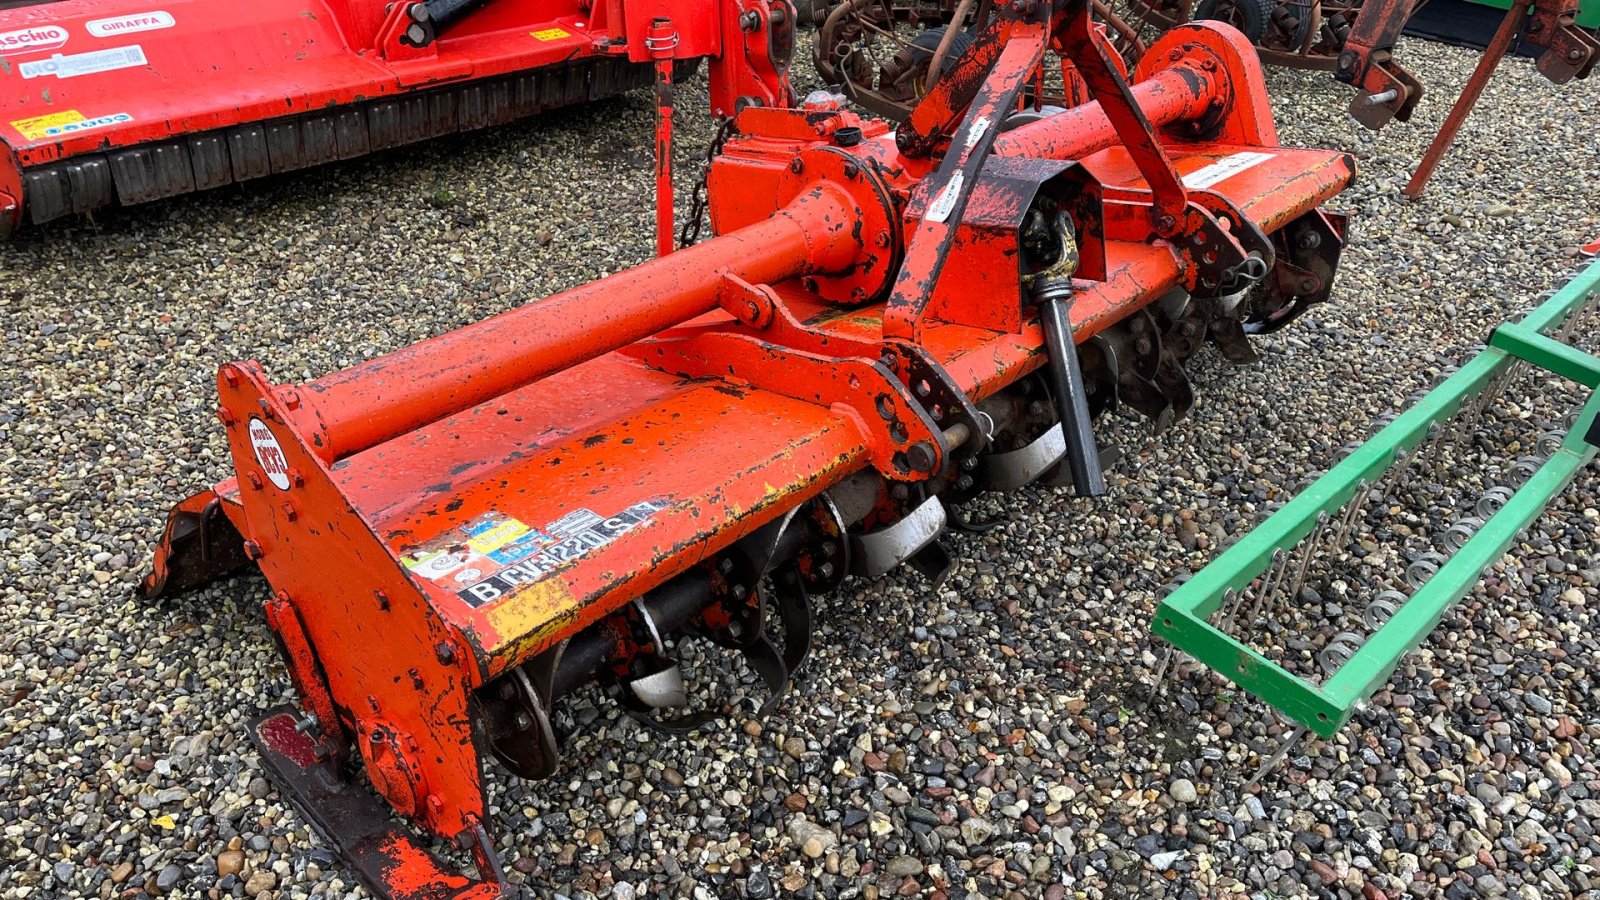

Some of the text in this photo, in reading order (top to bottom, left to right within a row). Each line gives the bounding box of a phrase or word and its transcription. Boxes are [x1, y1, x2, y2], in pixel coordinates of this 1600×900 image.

[101, 17, 160, 31] GIRAFFA
[467, 582, 502, 603] B
[551, 530, 602, 564] 220
